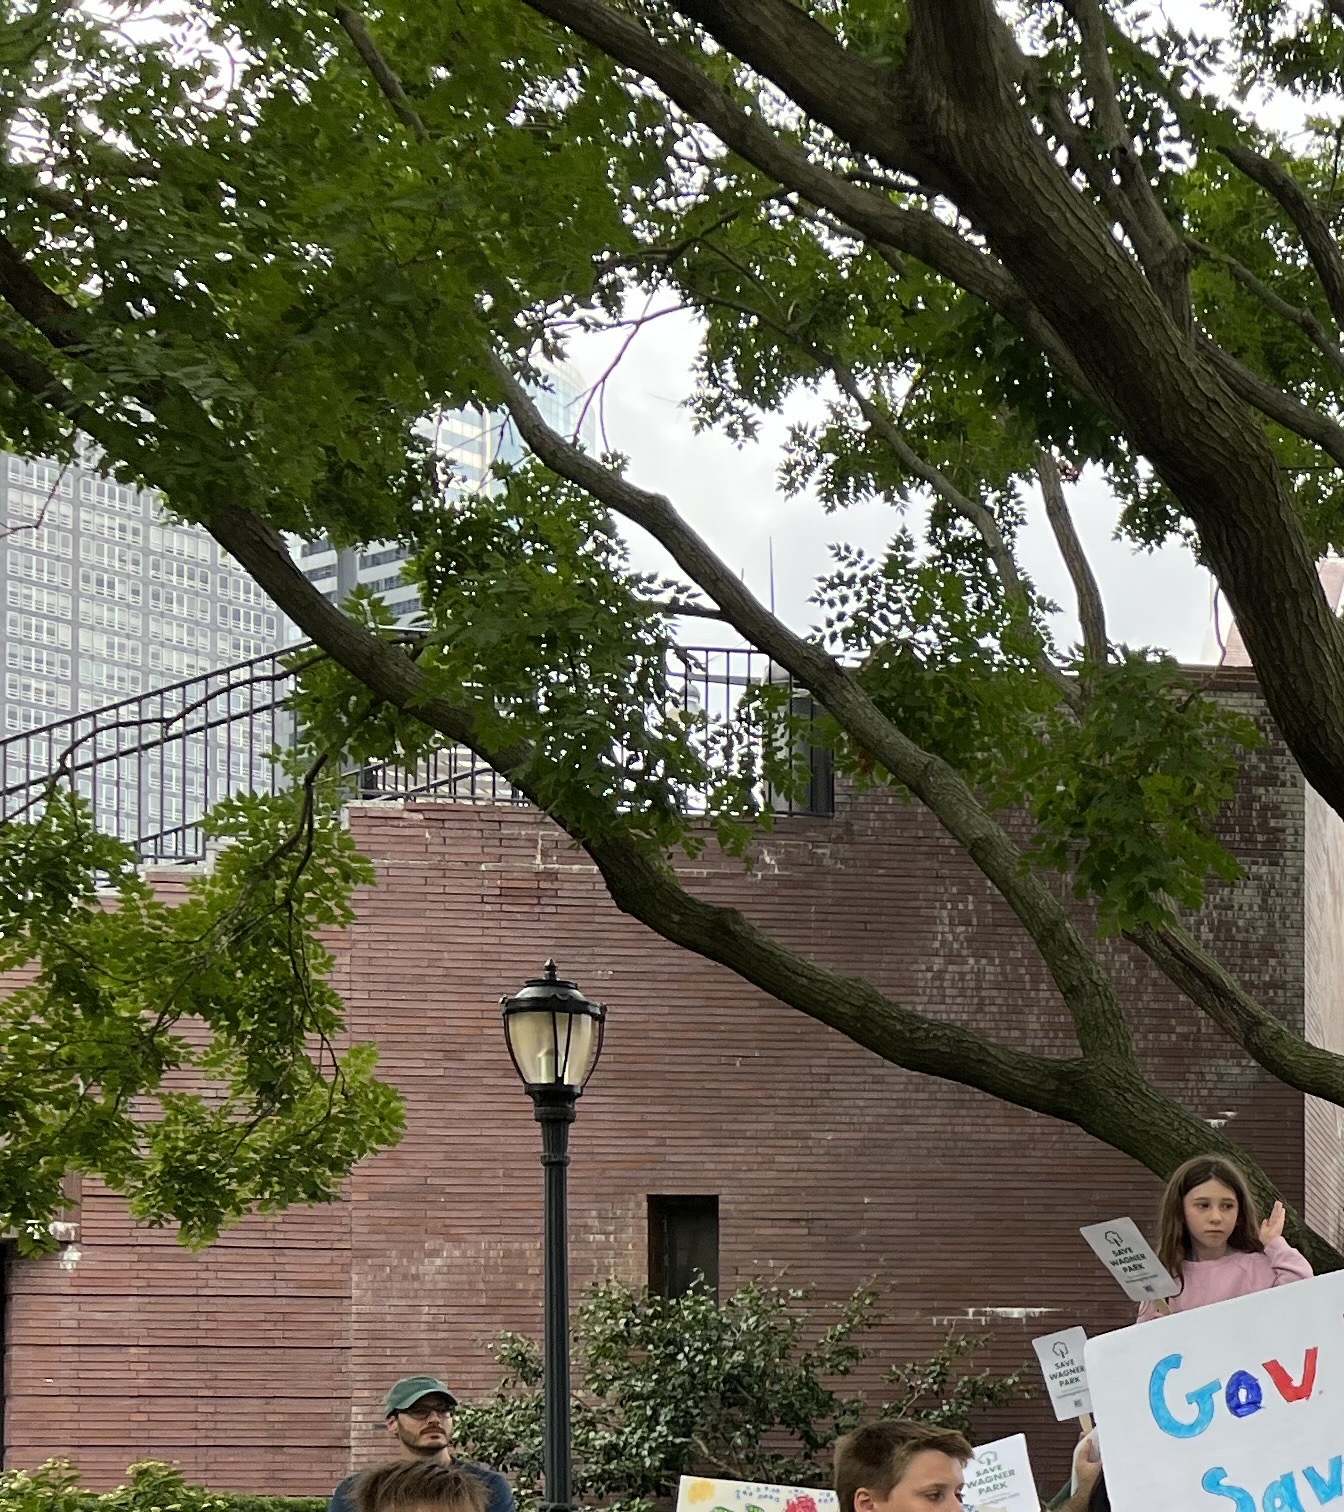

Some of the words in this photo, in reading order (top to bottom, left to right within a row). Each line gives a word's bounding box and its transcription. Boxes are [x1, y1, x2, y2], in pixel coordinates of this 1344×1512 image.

[1111, 1246, 1134, 1258] SAVE
[1109, 1253, 1148, 1267] WAGNER
[1122, 1263, 1146, 1274] PARK
[1054, 1358, 1075, 1370] SAVE
[1049, 1365, 1085, 1381] WAGNER
[1058, 1377, 1081, 1388] PARK
[975, 1464, 1002, 1478] SAVE
[965, 1469, 1016, 1489] WAGNER
[978, 1481, 1008, 1495] PARK
